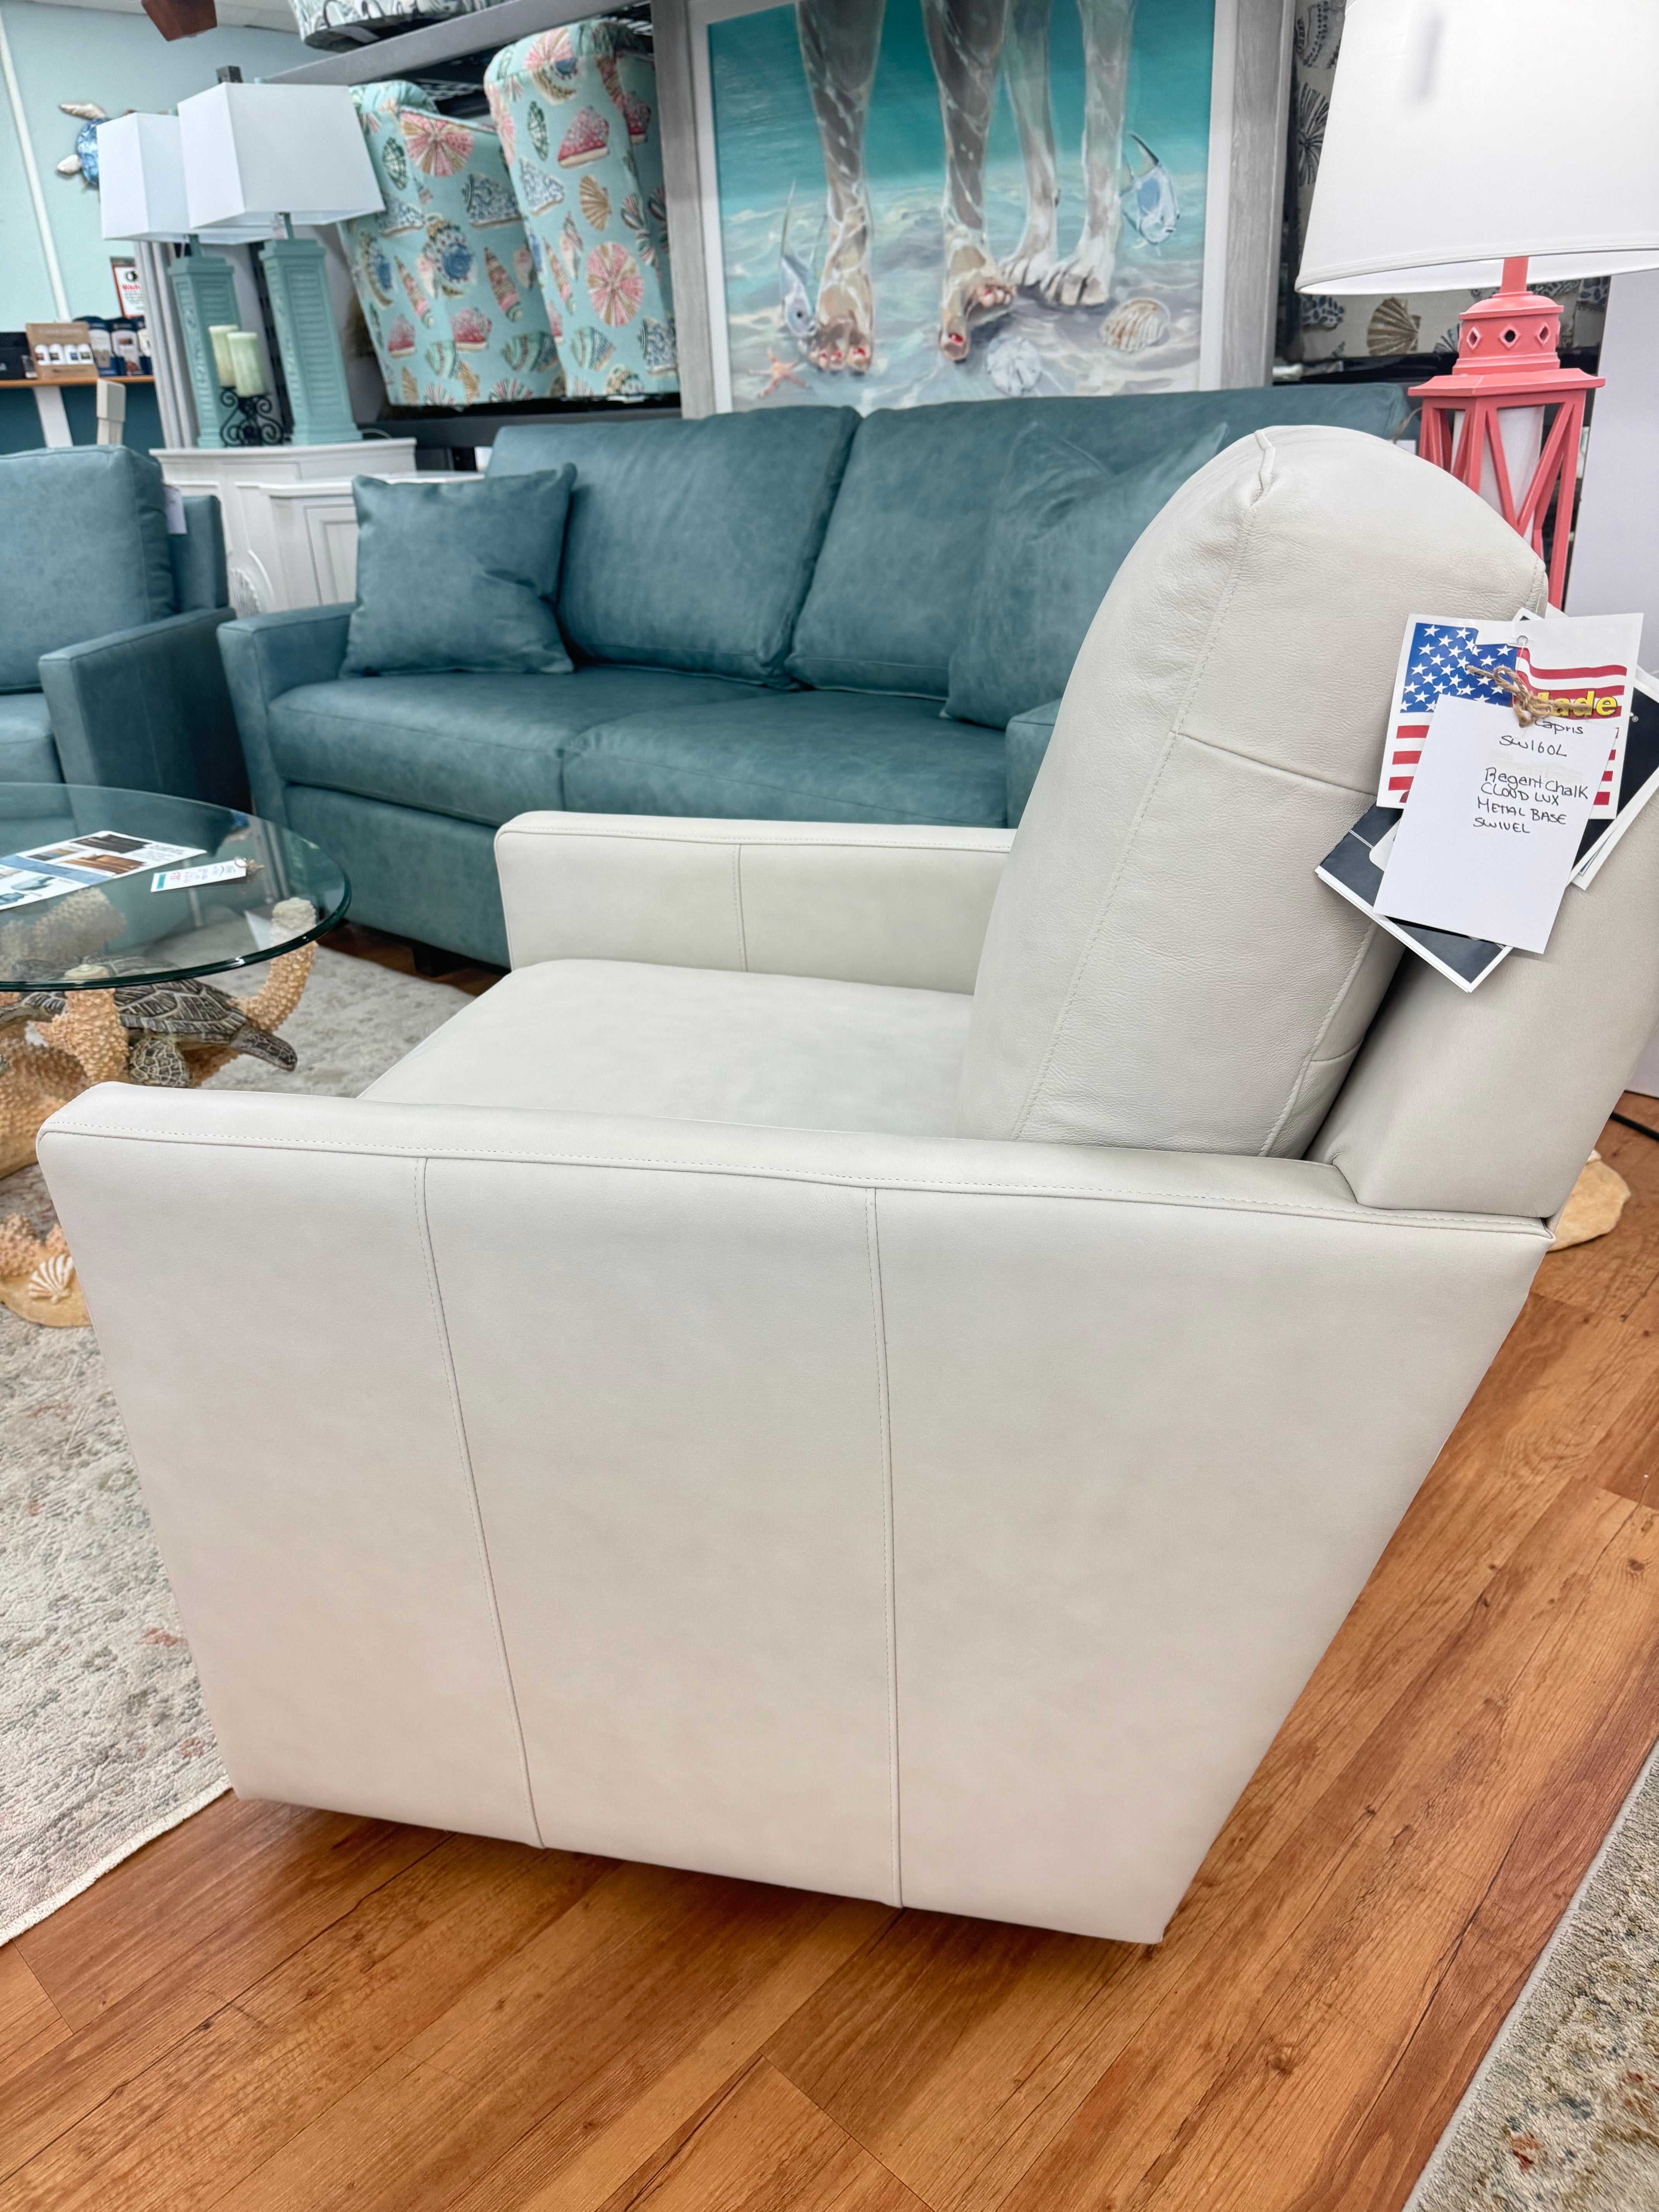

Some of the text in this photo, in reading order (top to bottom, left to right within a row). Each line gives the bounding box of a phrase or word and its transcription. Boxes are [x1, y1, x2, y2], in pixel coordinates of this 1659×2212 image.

[1486, 767, 1543, 790] Regent
[1481, 782, 1559, 806] CLOUD LUX
[1477, 796, 1567, 825] METAL BASE
[1473, 817, 1530, 833] SWIVEL
